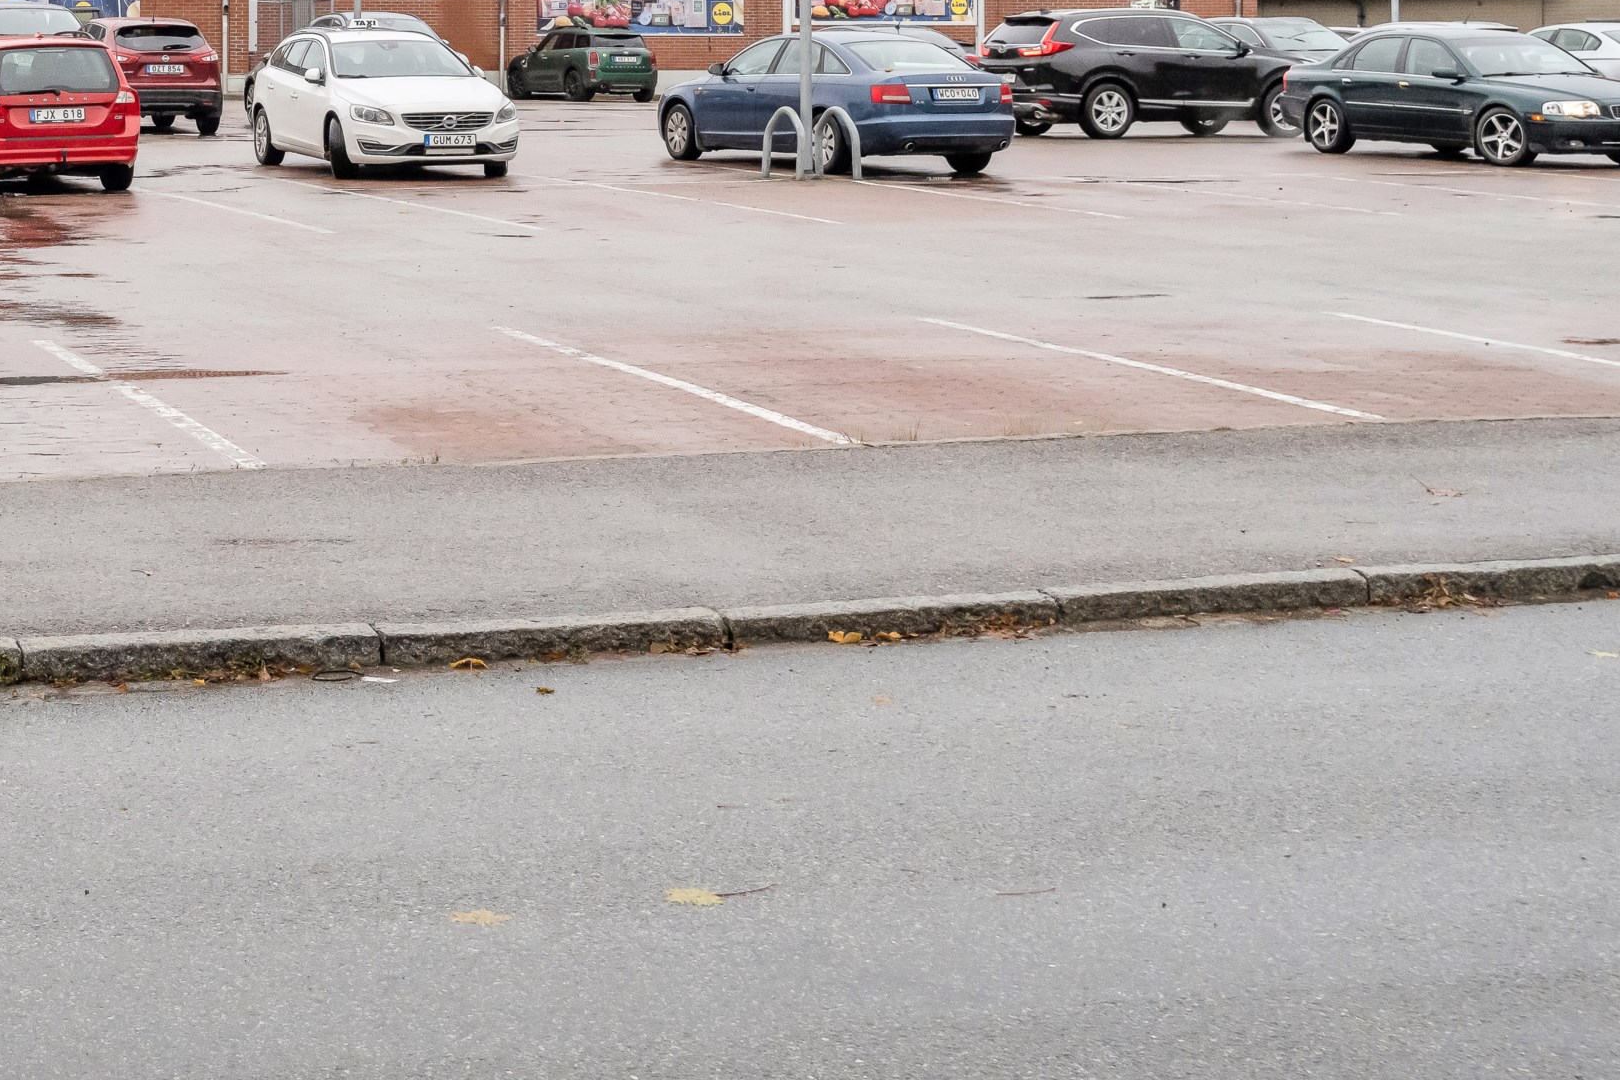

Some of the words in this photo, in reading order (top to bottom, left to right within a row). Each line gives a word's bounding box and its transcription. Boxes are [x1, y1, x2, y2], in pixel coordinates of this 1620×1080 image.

[939, 88, 956, 98] WCO
[961, 88, 977, 98] 040
[36, 110, 56, 120] FJX
[63, 109, 83, 119] 618
[433, 136, 452, 145] GUM
[454, 136, 472, 145] 673
